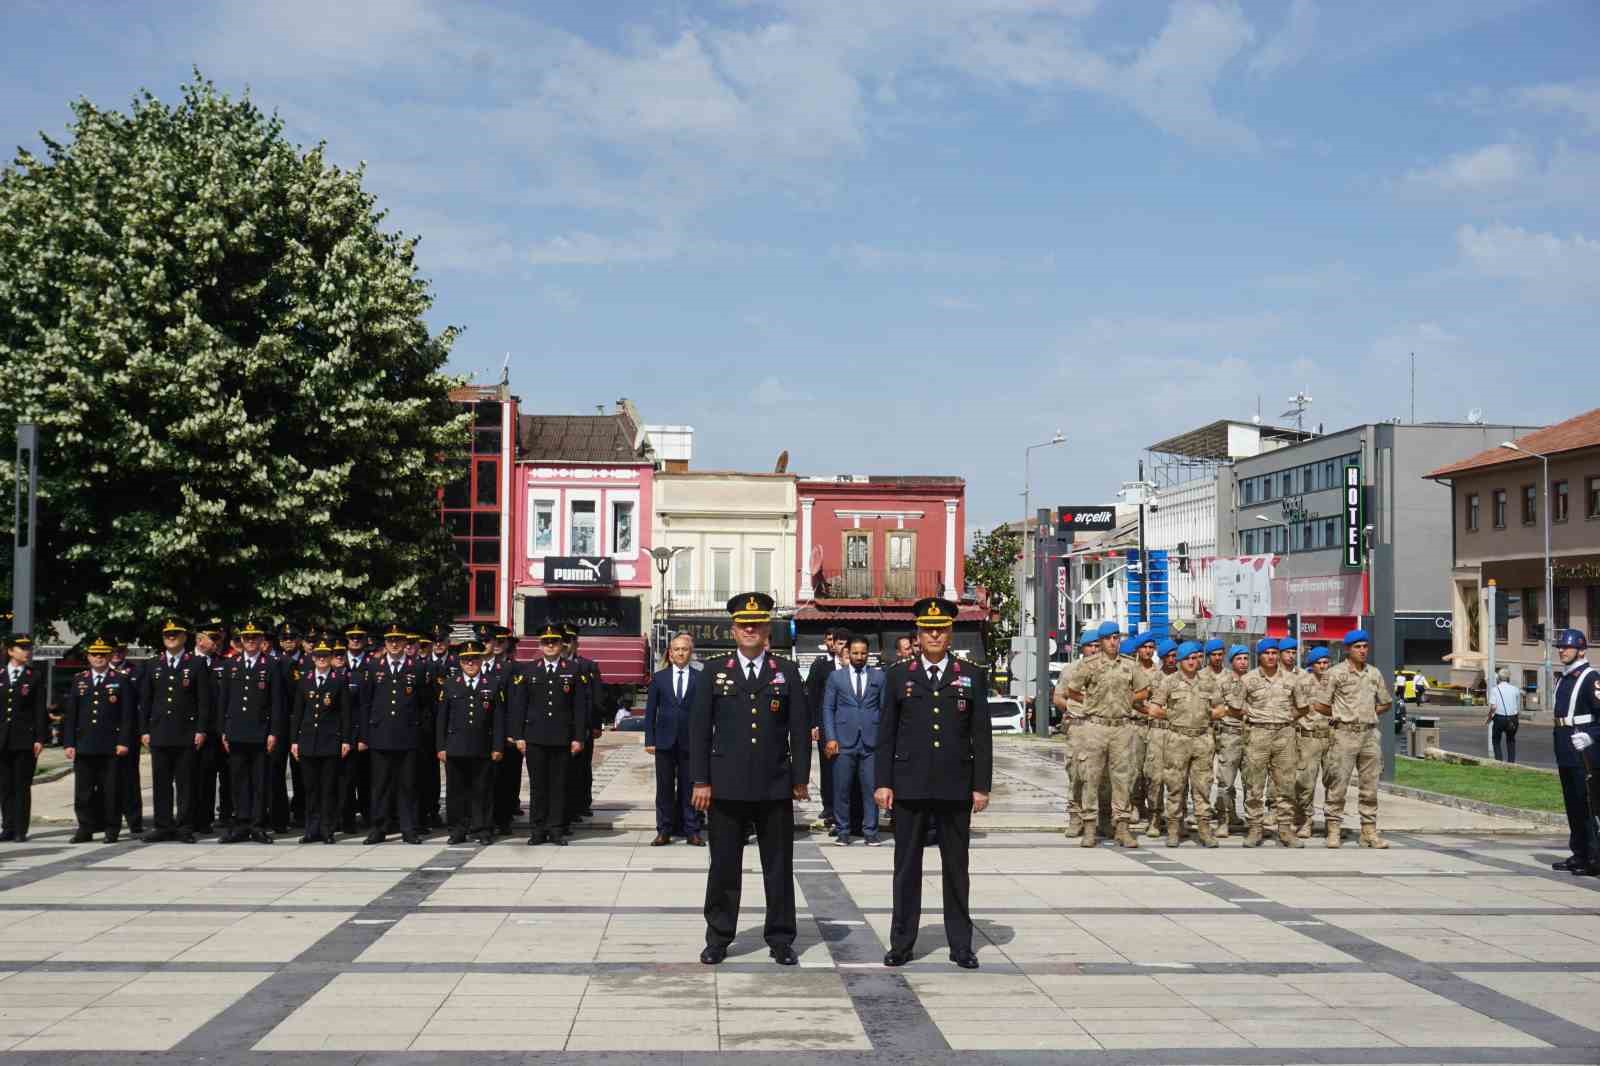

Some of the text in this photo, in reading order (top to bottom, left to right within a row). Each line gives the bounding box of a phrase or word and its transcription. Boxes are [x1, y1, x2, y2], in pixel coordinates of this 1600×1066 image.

[1074, 512, 1113, 525] arçelik
[1348, 468, 1358, 564] HOTEL
[553, 568, 593, 581] PUMA
